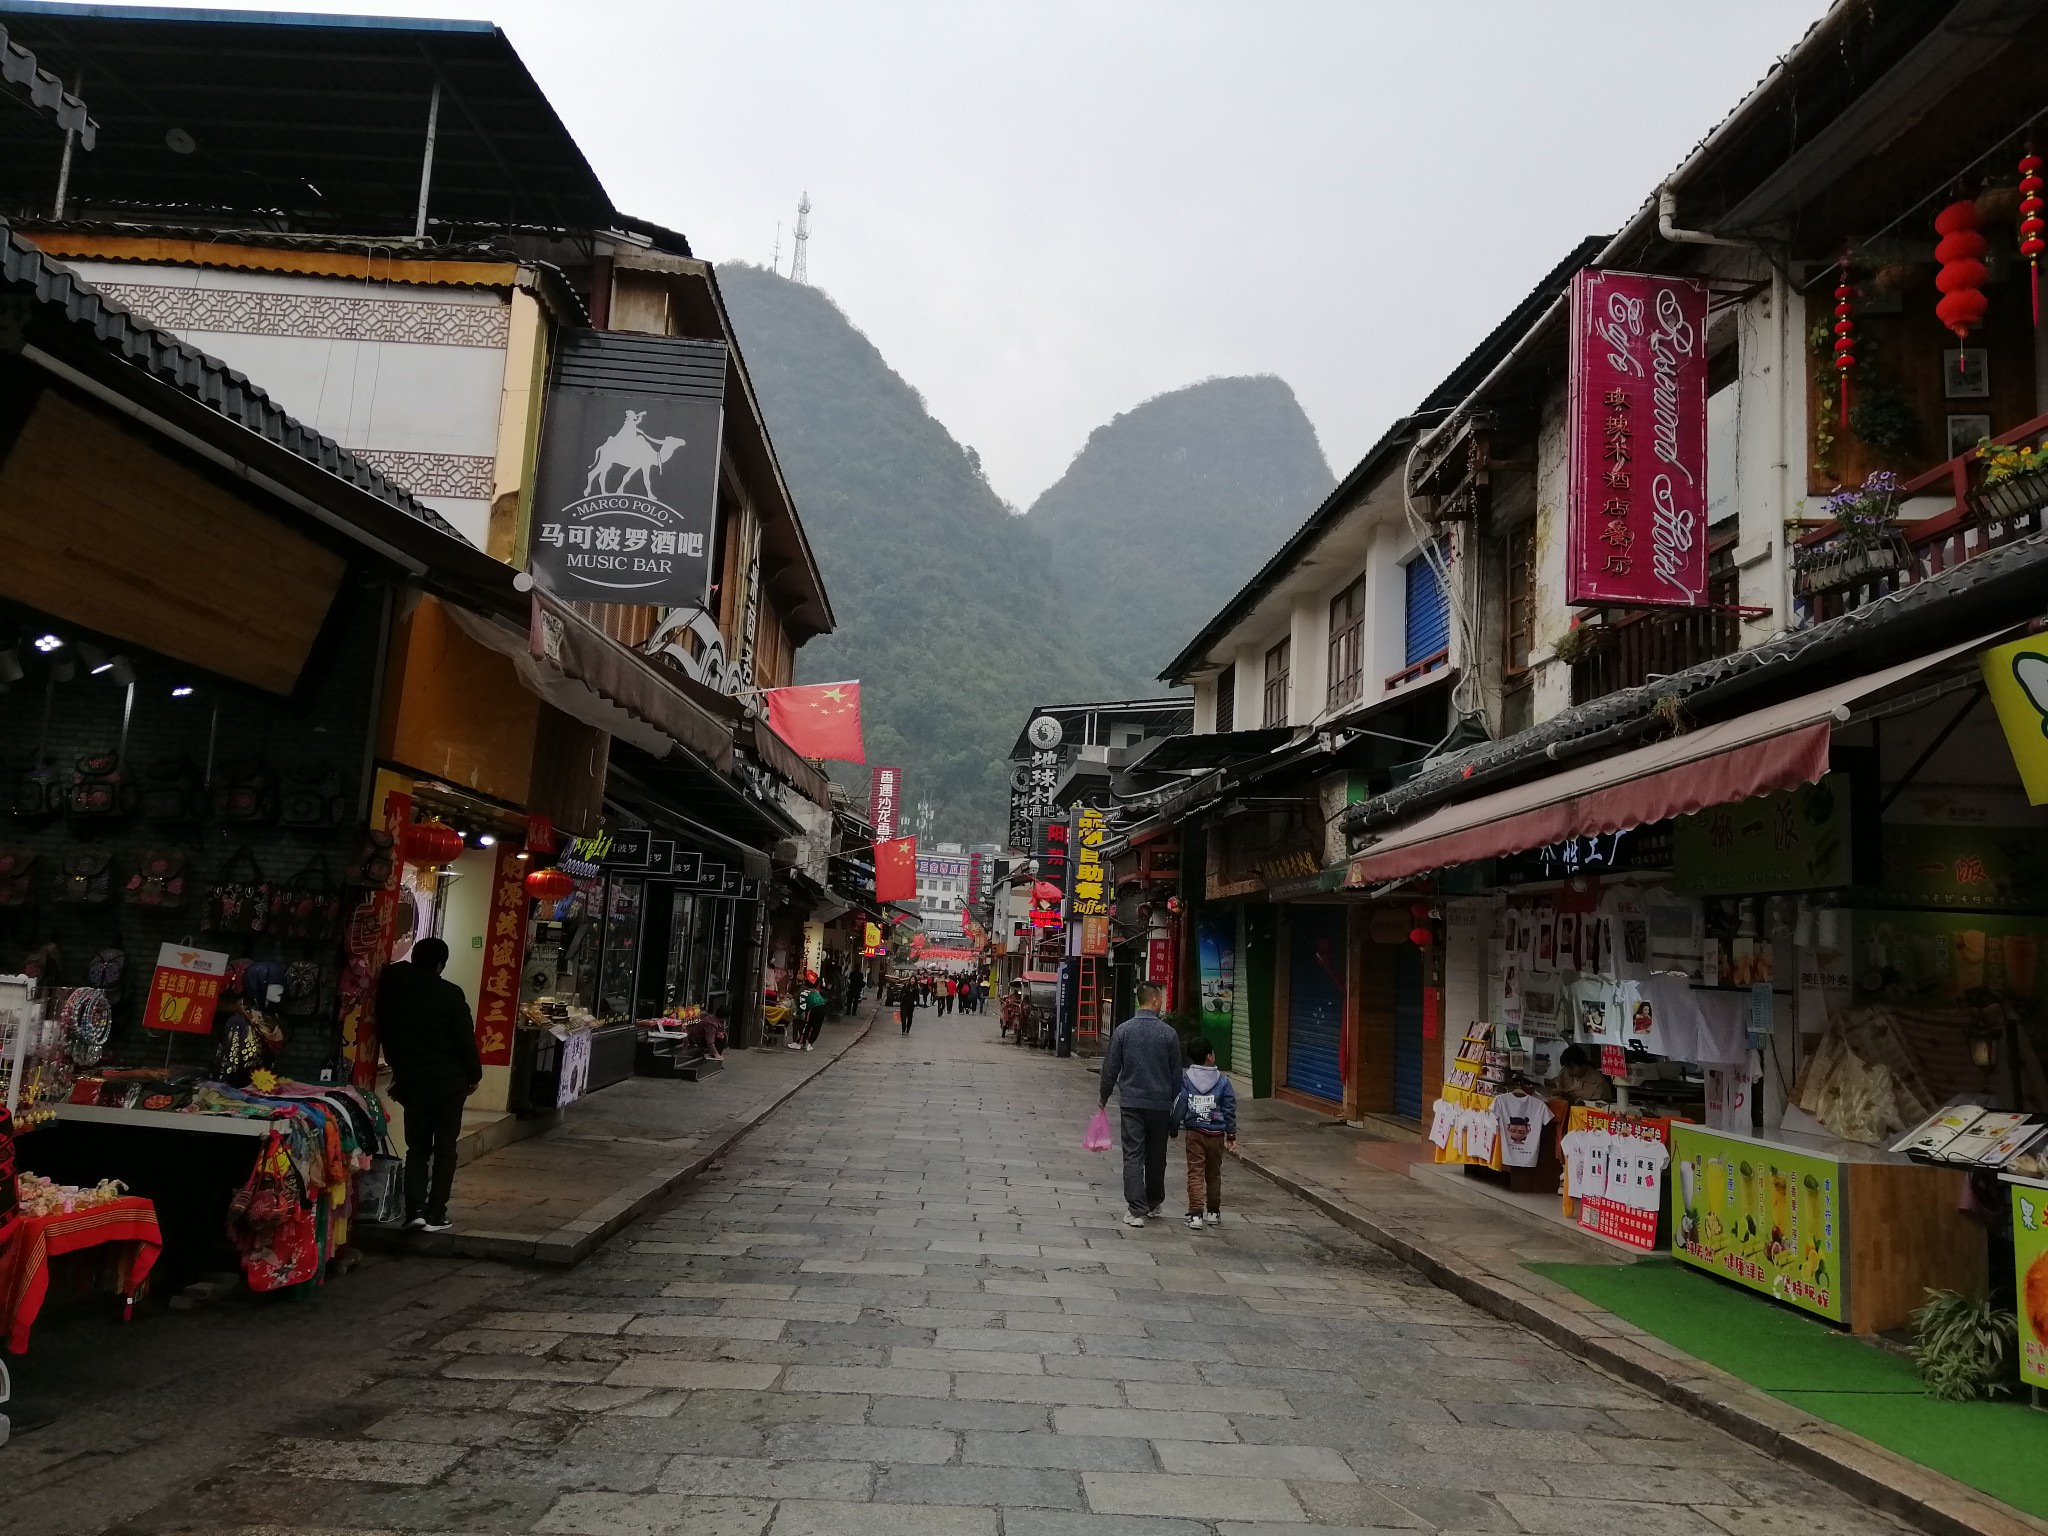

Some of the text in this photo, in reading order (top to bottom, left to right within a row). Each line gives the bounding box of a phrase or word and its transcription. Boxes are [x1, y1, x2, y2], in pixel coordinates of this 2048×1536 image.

[1648, 288, 1696, 607] Rosewood Hotel
[576, 498, 669, 522] MARCO POLO
[539, 523, 704, 558] 马可波罗酒吧
[566, 553, 673, 574] MUSIC BAR
[1028, 750, 1057, 805] 地球村
[1010, 794, 1032, 837] 地球村
[1028, 805, 1054, 818] 酒吧
[1010, 837, 1031, 847] 酒吧
[1724, 1252, 1765, 1283] 健康绿色
